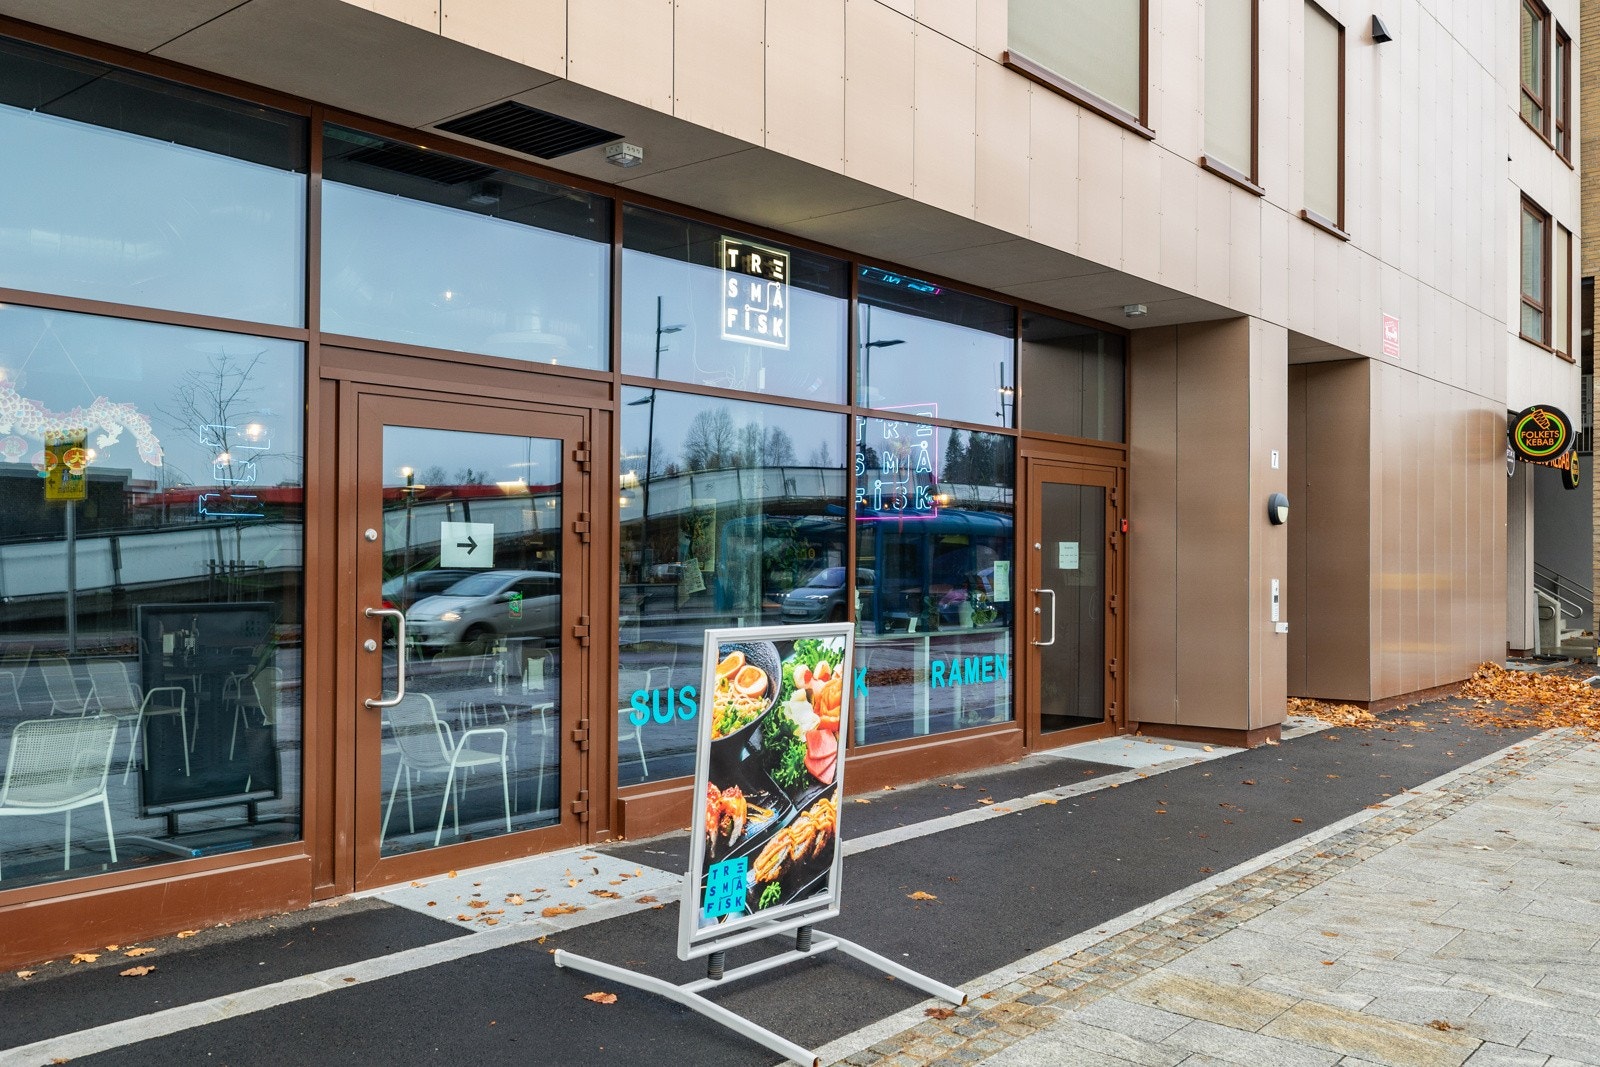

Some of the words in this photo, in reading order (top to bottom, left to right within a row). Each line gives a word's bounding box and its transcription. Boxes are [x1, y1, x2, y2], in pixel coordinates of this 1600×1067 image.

[728, 248, 784, 280] TRE
[728, 278, 784, 309] SMÅ
[727, 304, 784, 338] FISK
[931, 653, 1008, 689] RAMEN
[629, 685, 698, 727] SUS
[712, 862, 744, 880] TRE
[706, 897, 743, 913] FISK
